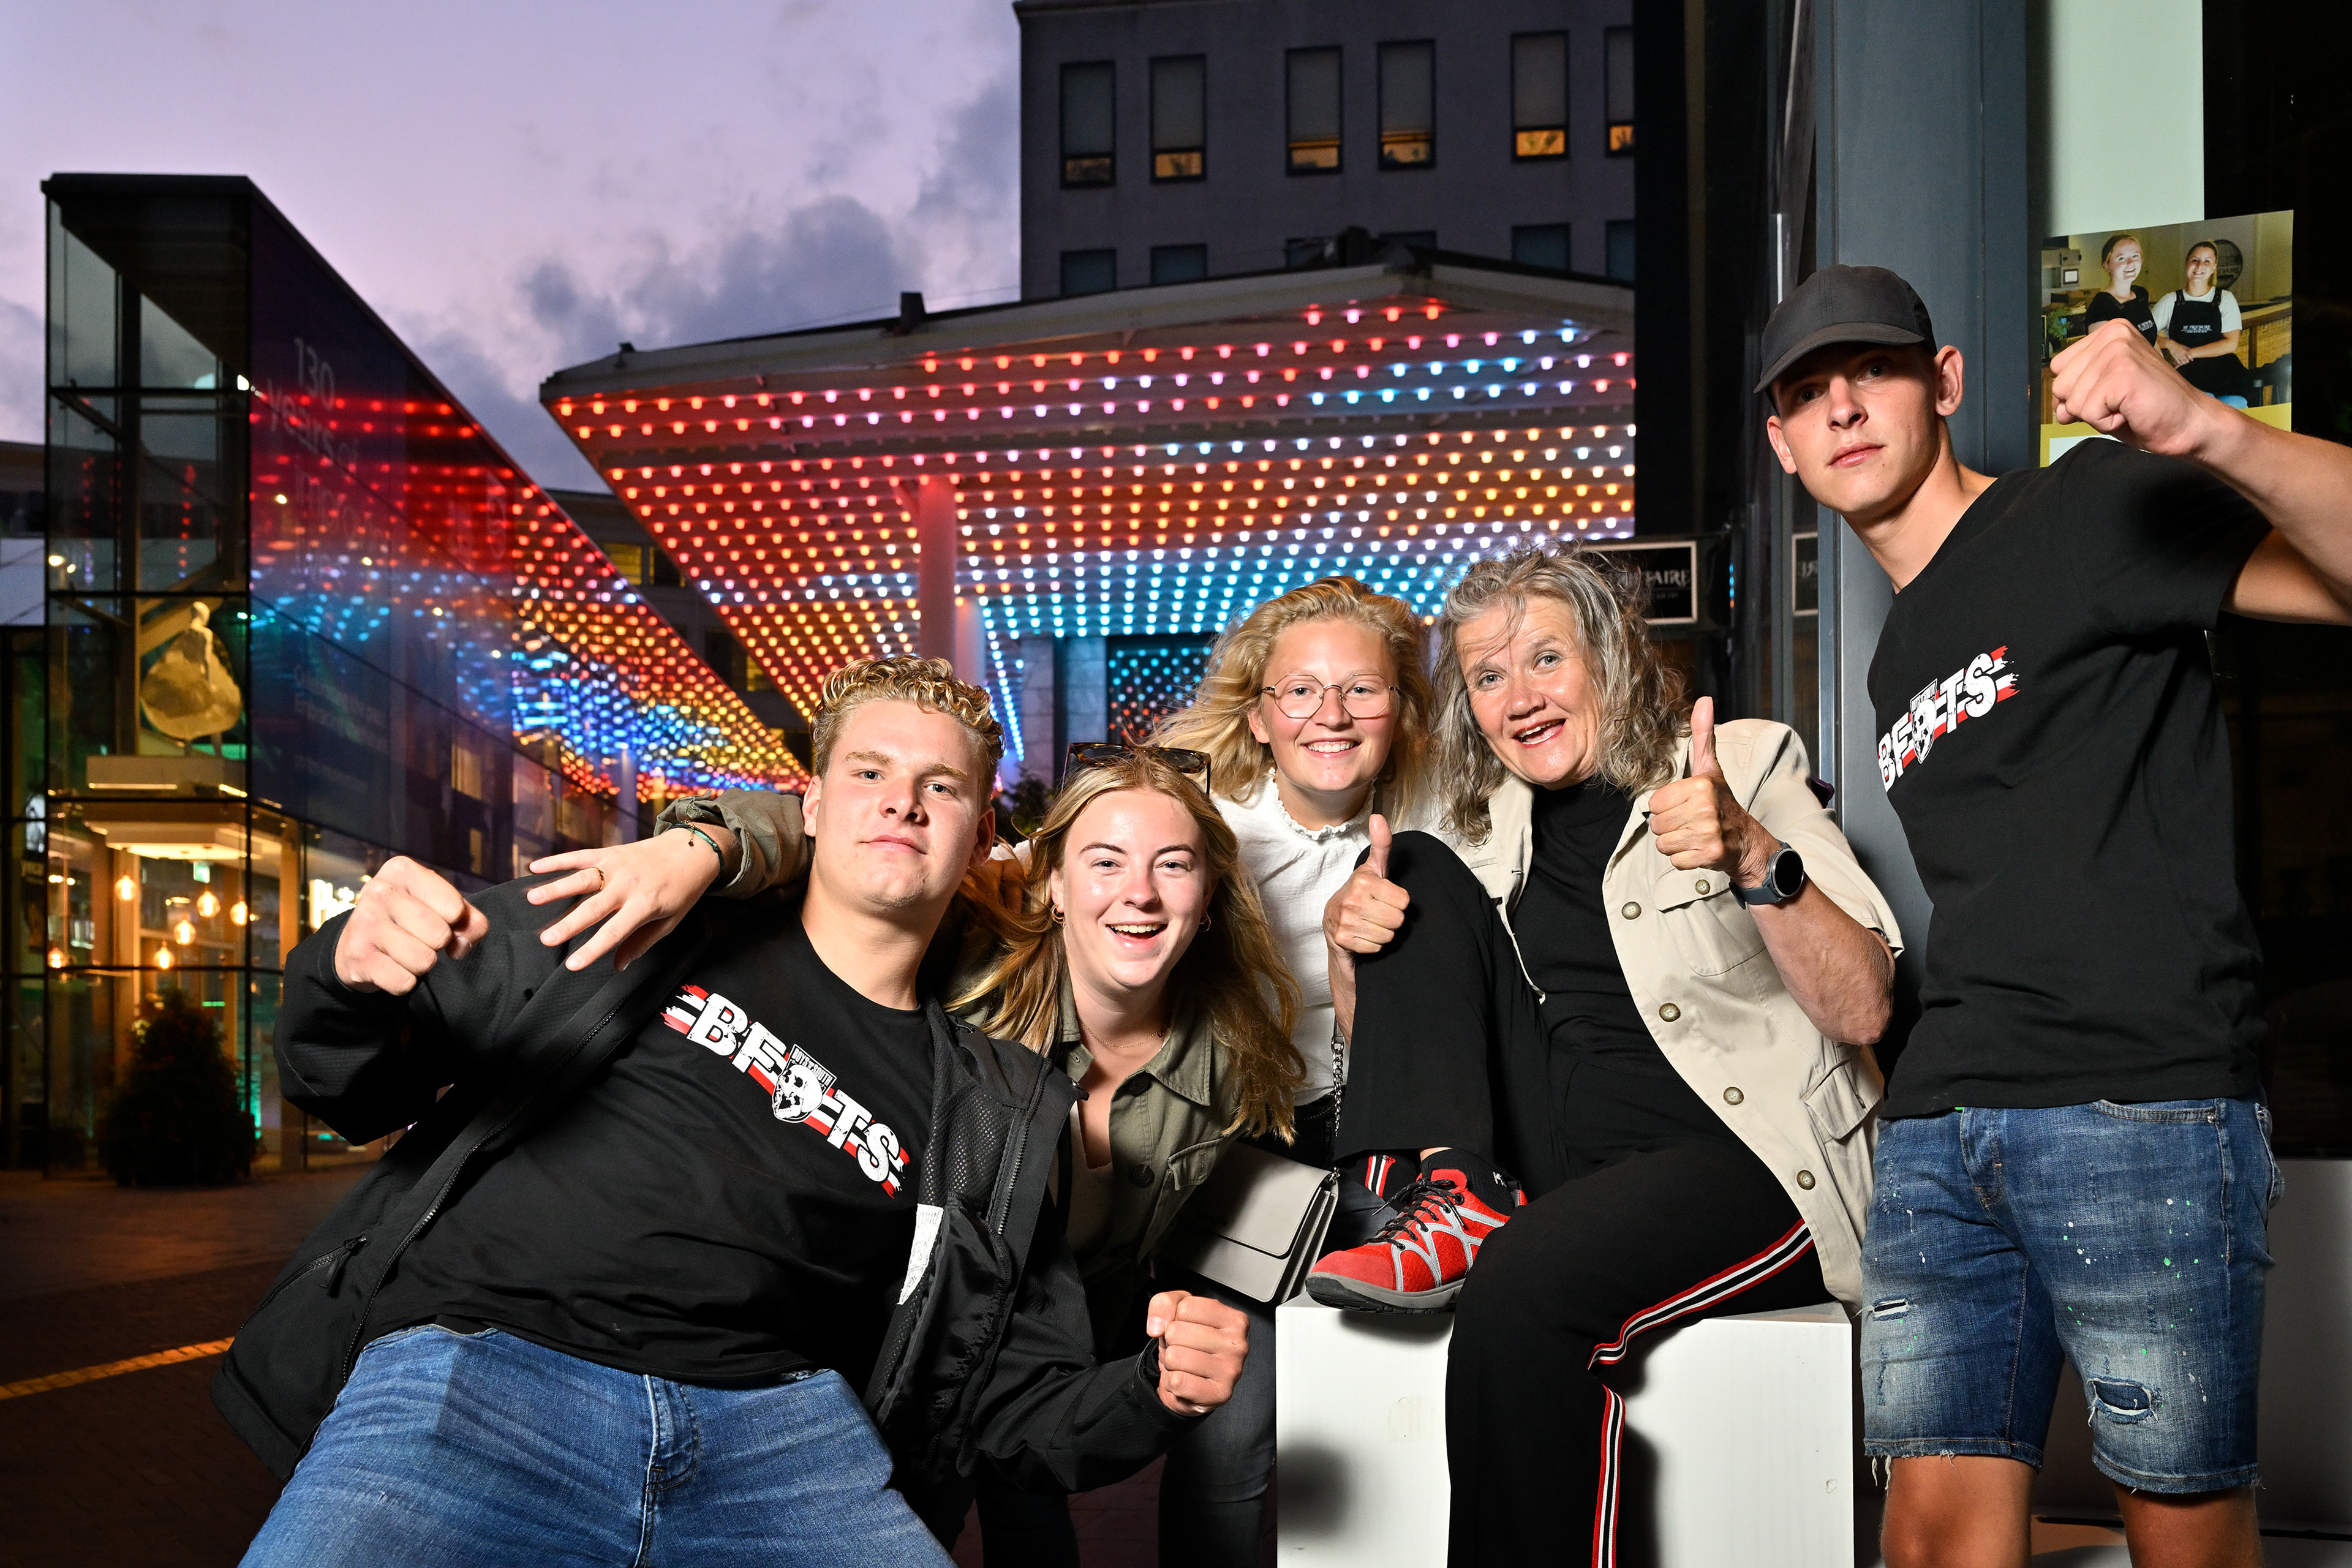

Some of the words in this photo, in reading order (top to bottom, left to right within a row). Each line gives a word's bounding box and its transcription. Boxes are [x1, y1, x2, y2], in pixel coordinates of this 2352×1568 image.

[293, 337, 335, 412] 130
[791, 1047, 810, 1066] BOYS
[811, 1063, 834, 1087] SOUTH
